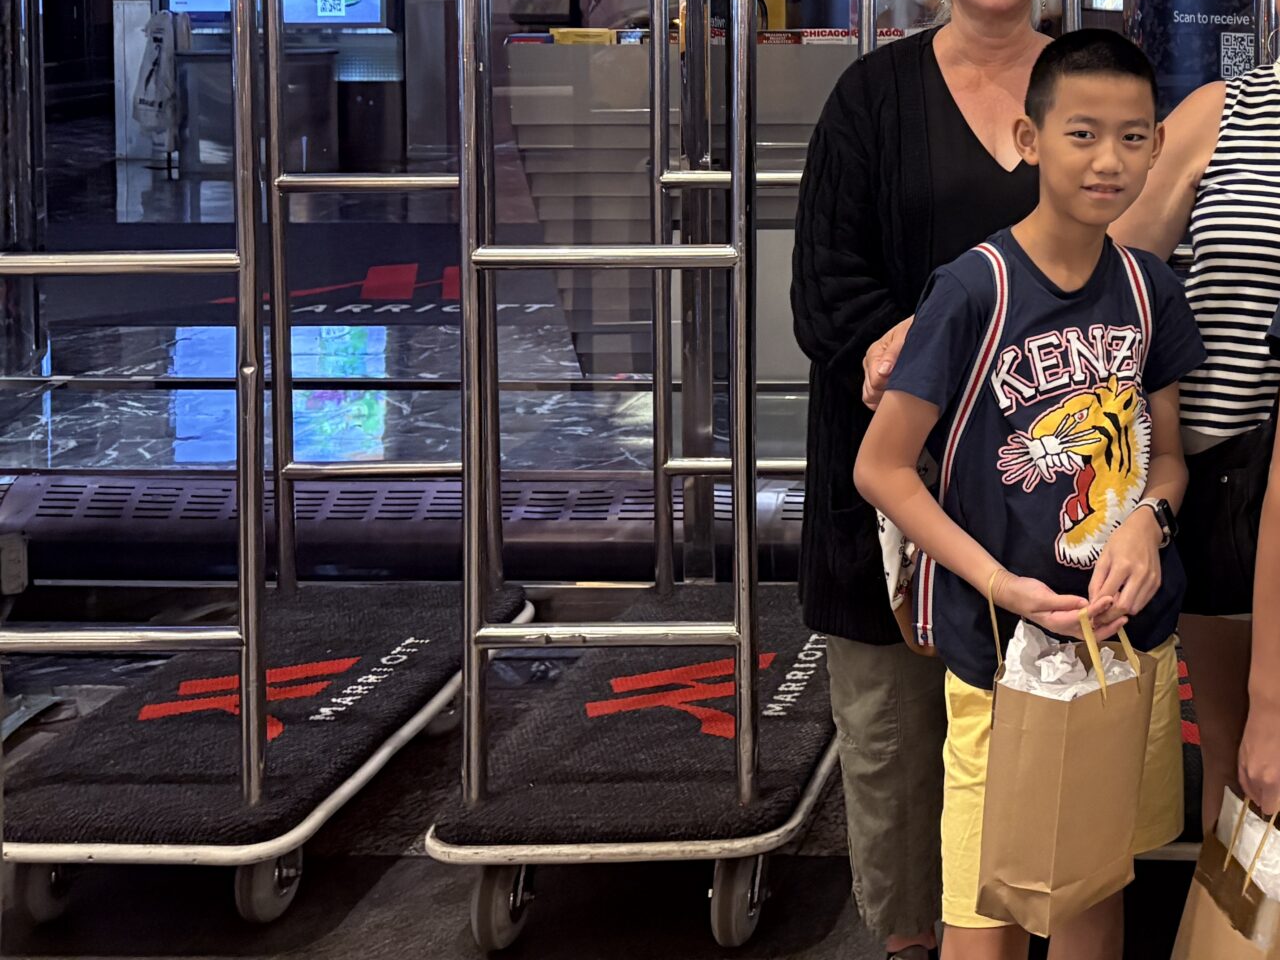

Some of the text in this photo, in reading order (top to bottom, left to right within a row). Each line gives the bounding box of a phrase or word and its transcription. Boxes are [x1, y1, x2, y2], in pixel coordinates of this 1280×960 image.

[802, 30, 846, 38] CHICAGO
[1173, 10, 1197, 24] Scan
[1198, 13, 1209, 25] to
[1210, 13, 1251, 26] receive
[989, 324, 1143, 416] KENZ
[308, 636, 430, 721] MARRIOTT
[761, 633, 828, 717] MARRIOTT
